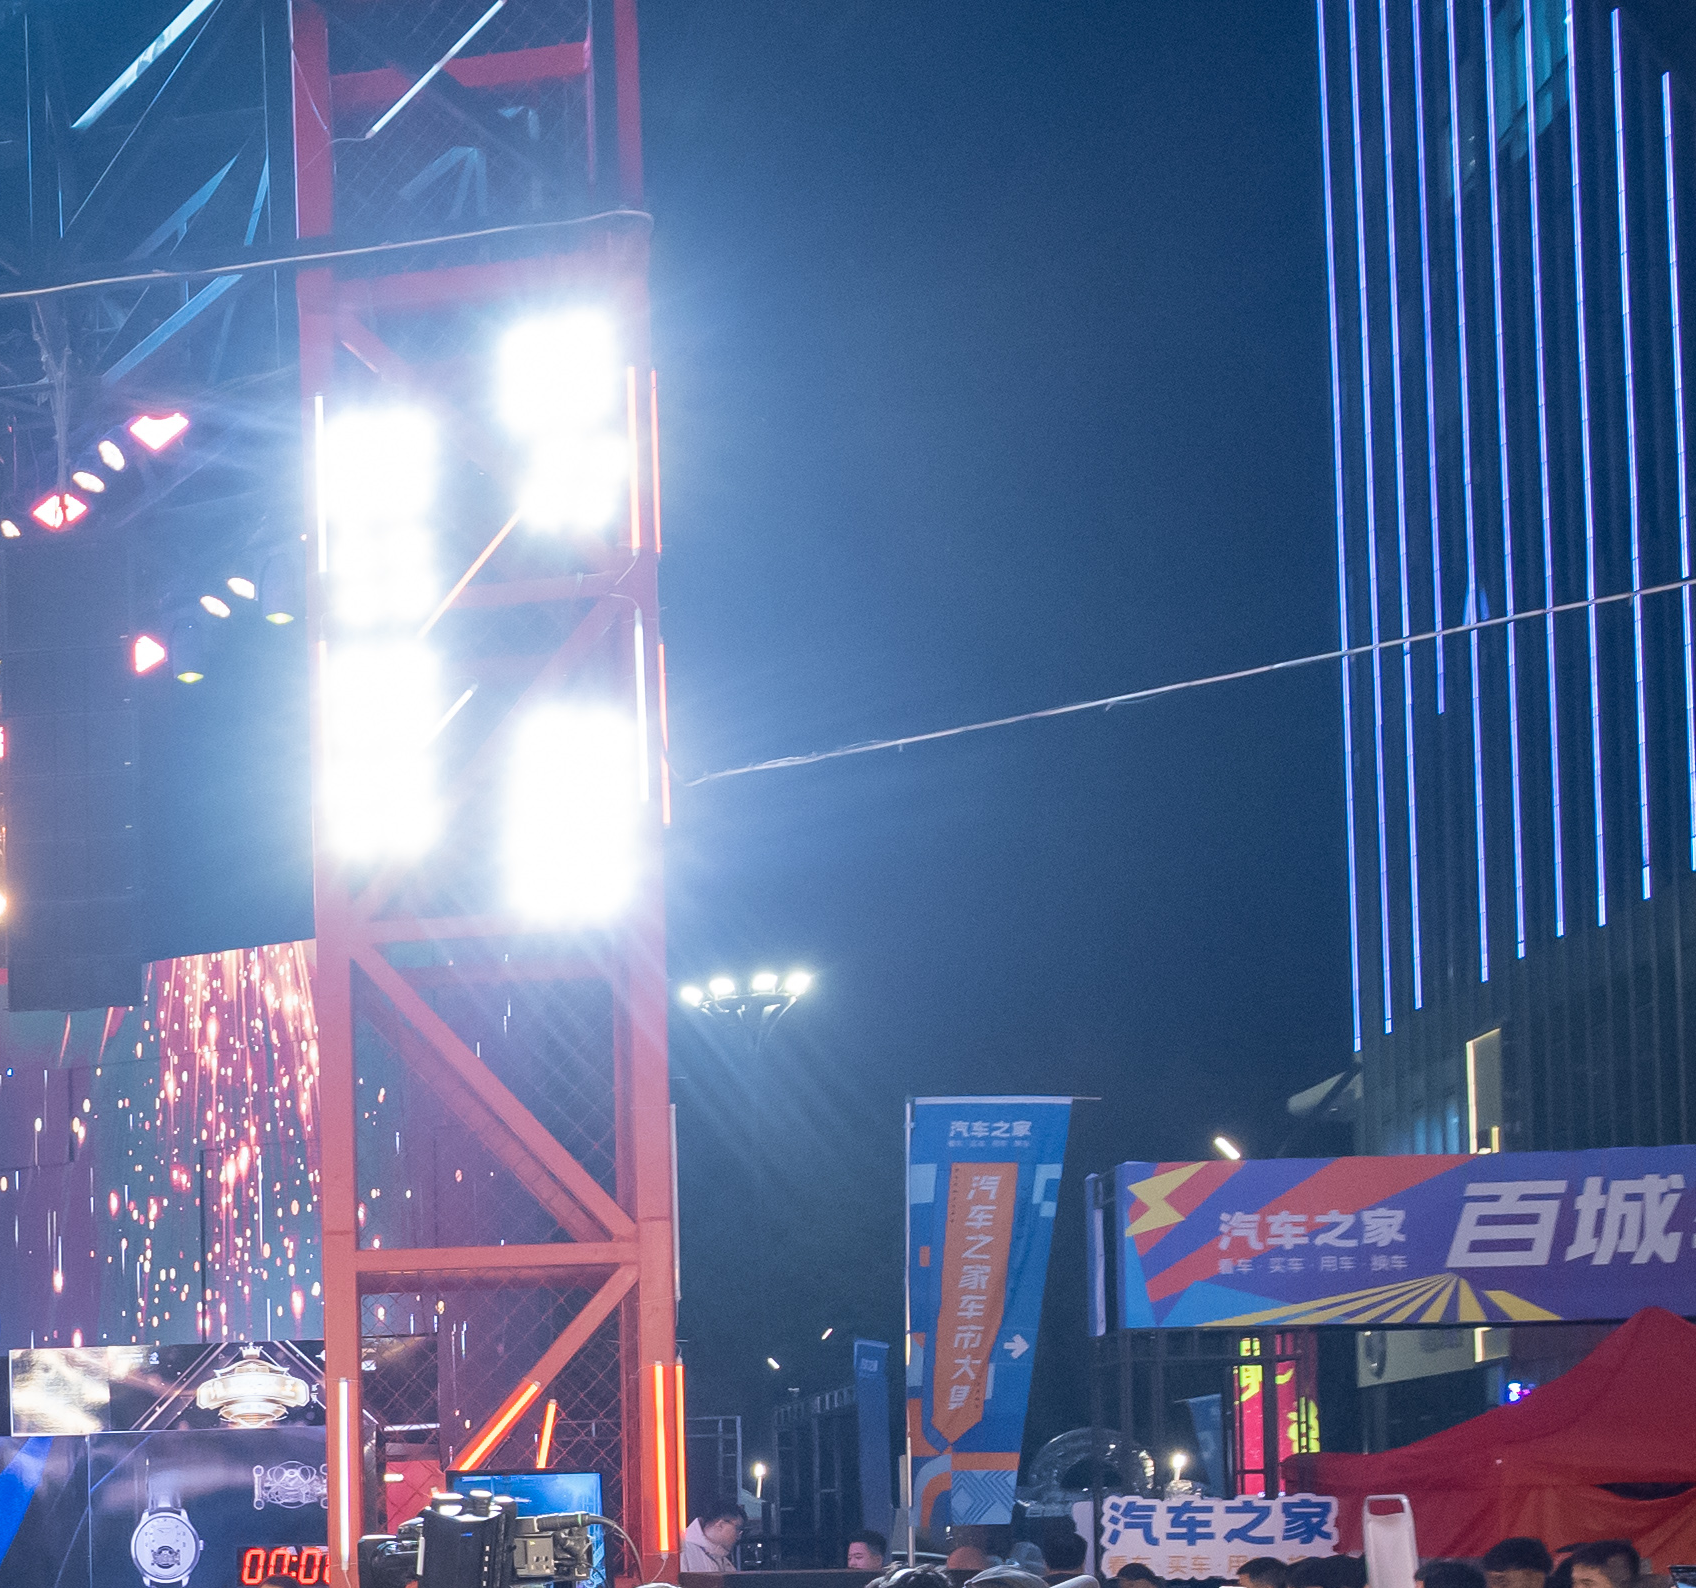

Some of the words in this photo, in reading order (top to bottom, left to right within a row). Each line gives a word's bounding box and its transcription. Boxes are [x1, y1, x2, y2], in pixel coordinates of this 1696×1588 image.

[949, 1120, 1033, 1138] 汽车之家
[1218, 1207, 1407, 1251] 汽车之家
[1445, 1173, 1696, 1269] 百城
[947, 1174, 1002, 1412] 汽车之家车市大集
[1108, 1499, 1333, 1547] 汽车之家
[1168, 1554, 1211, 1575] 买车
